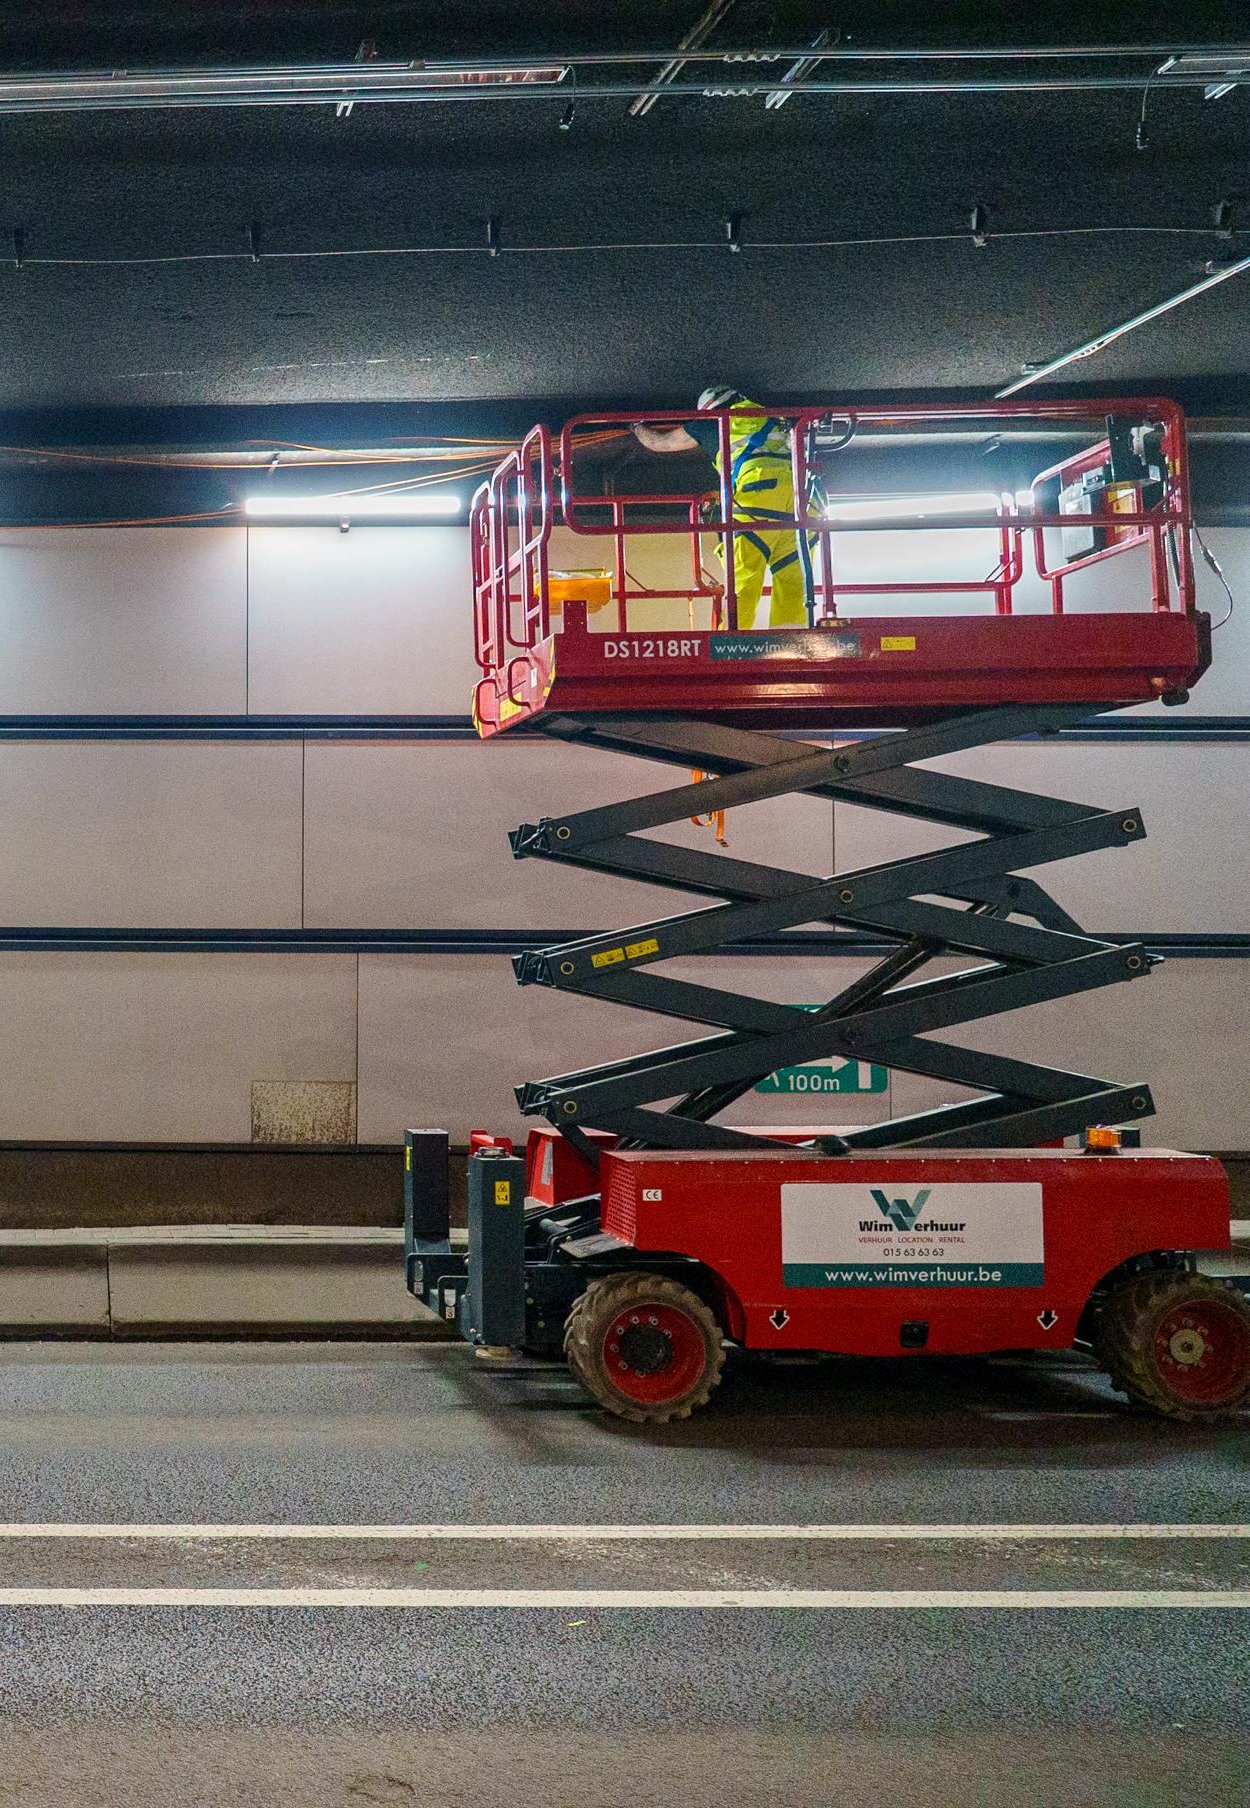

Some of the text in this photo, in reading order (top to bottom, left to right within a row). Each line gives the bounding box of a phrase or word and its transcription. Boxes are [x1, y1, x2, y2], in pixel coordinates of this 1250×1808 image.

[604, 639, 701, 658] DS1218RT
[788, 1075, 840, 1091] 100m
[883, 1248, 944, 1257] 015 63 63 63
[825, 1266, 1002, 1282] www.wimverhuur.be
